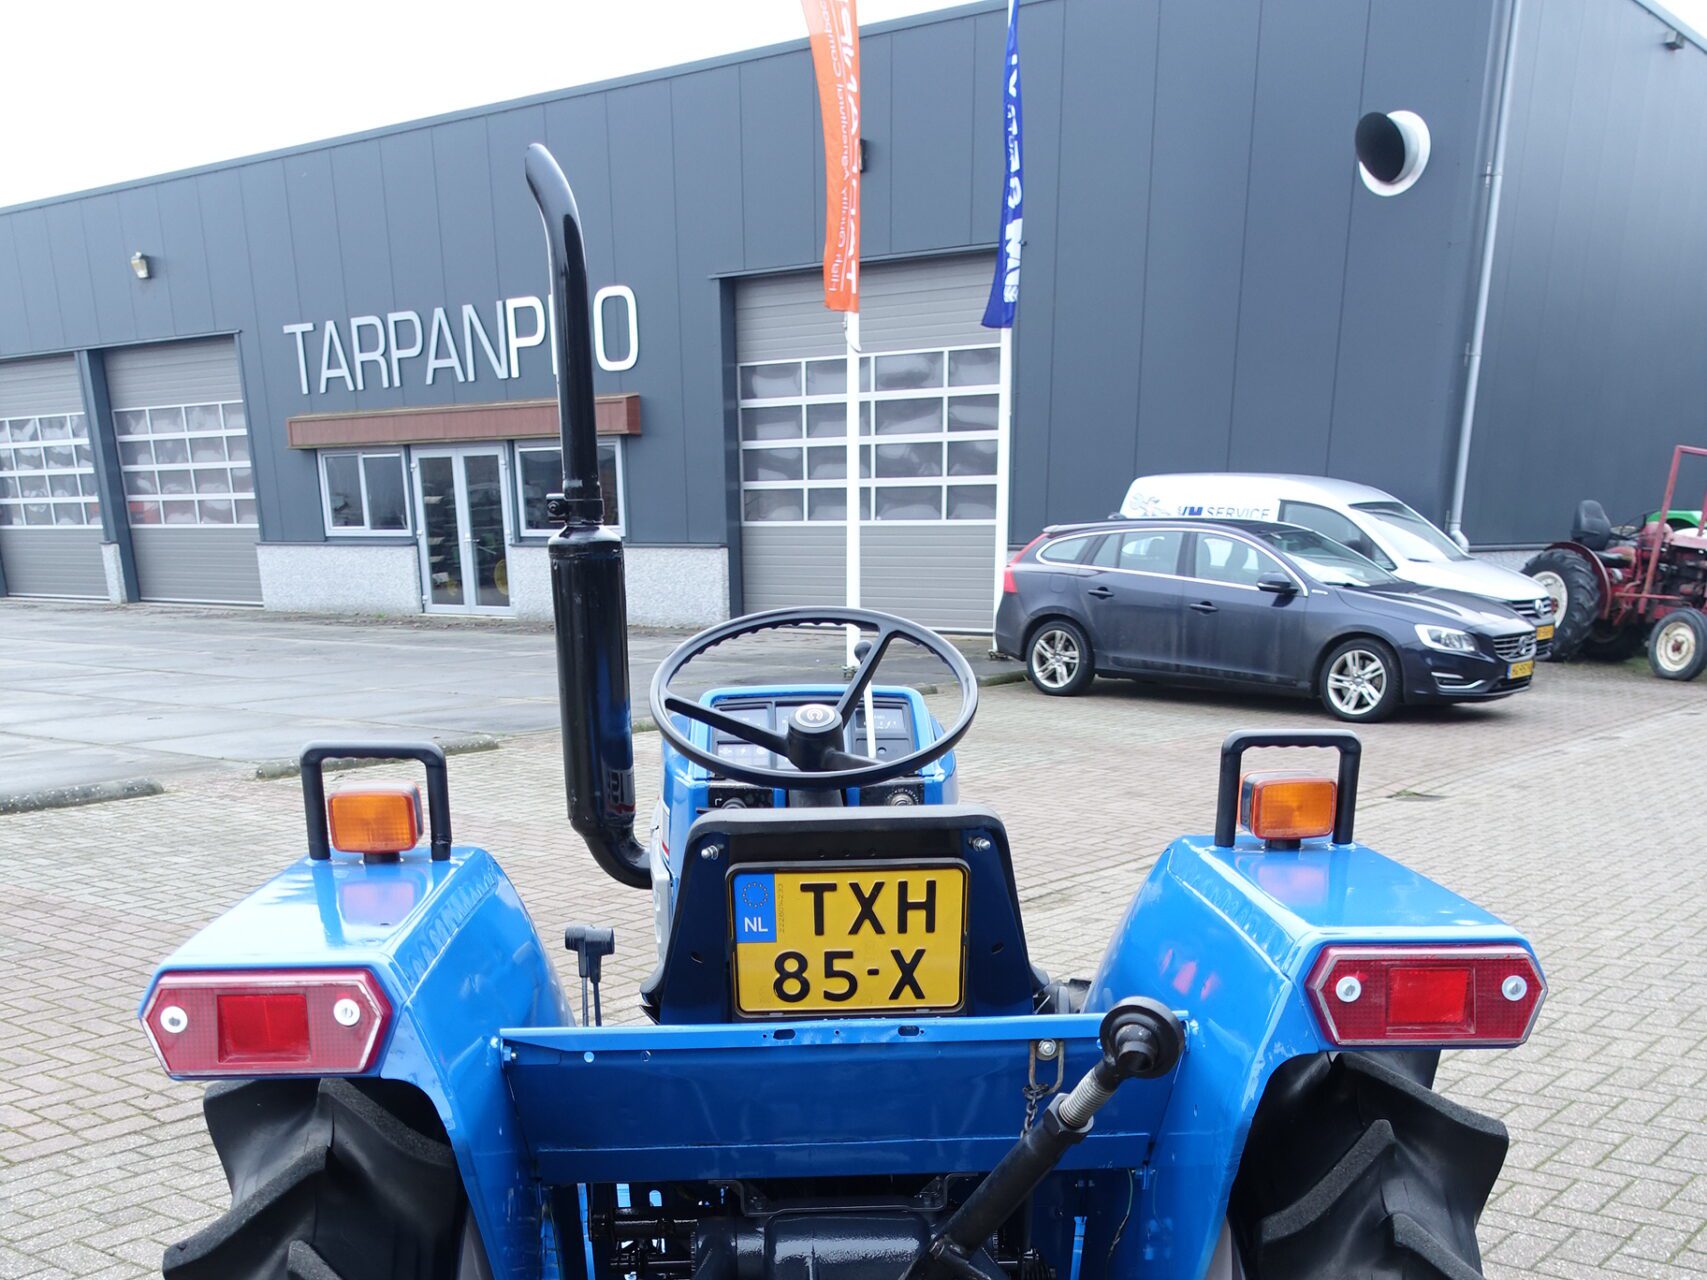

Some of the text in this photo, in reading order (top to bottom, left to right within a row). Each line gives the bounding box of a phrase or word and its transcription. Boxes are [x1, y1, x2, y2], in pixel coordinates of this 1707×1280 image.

[283, 284, 640, 395] TARPANPO
[743, 915, 769, 934] NL
[799, 879, 937, 937] TXH
[772, 948, 927, 1003] 85-X
